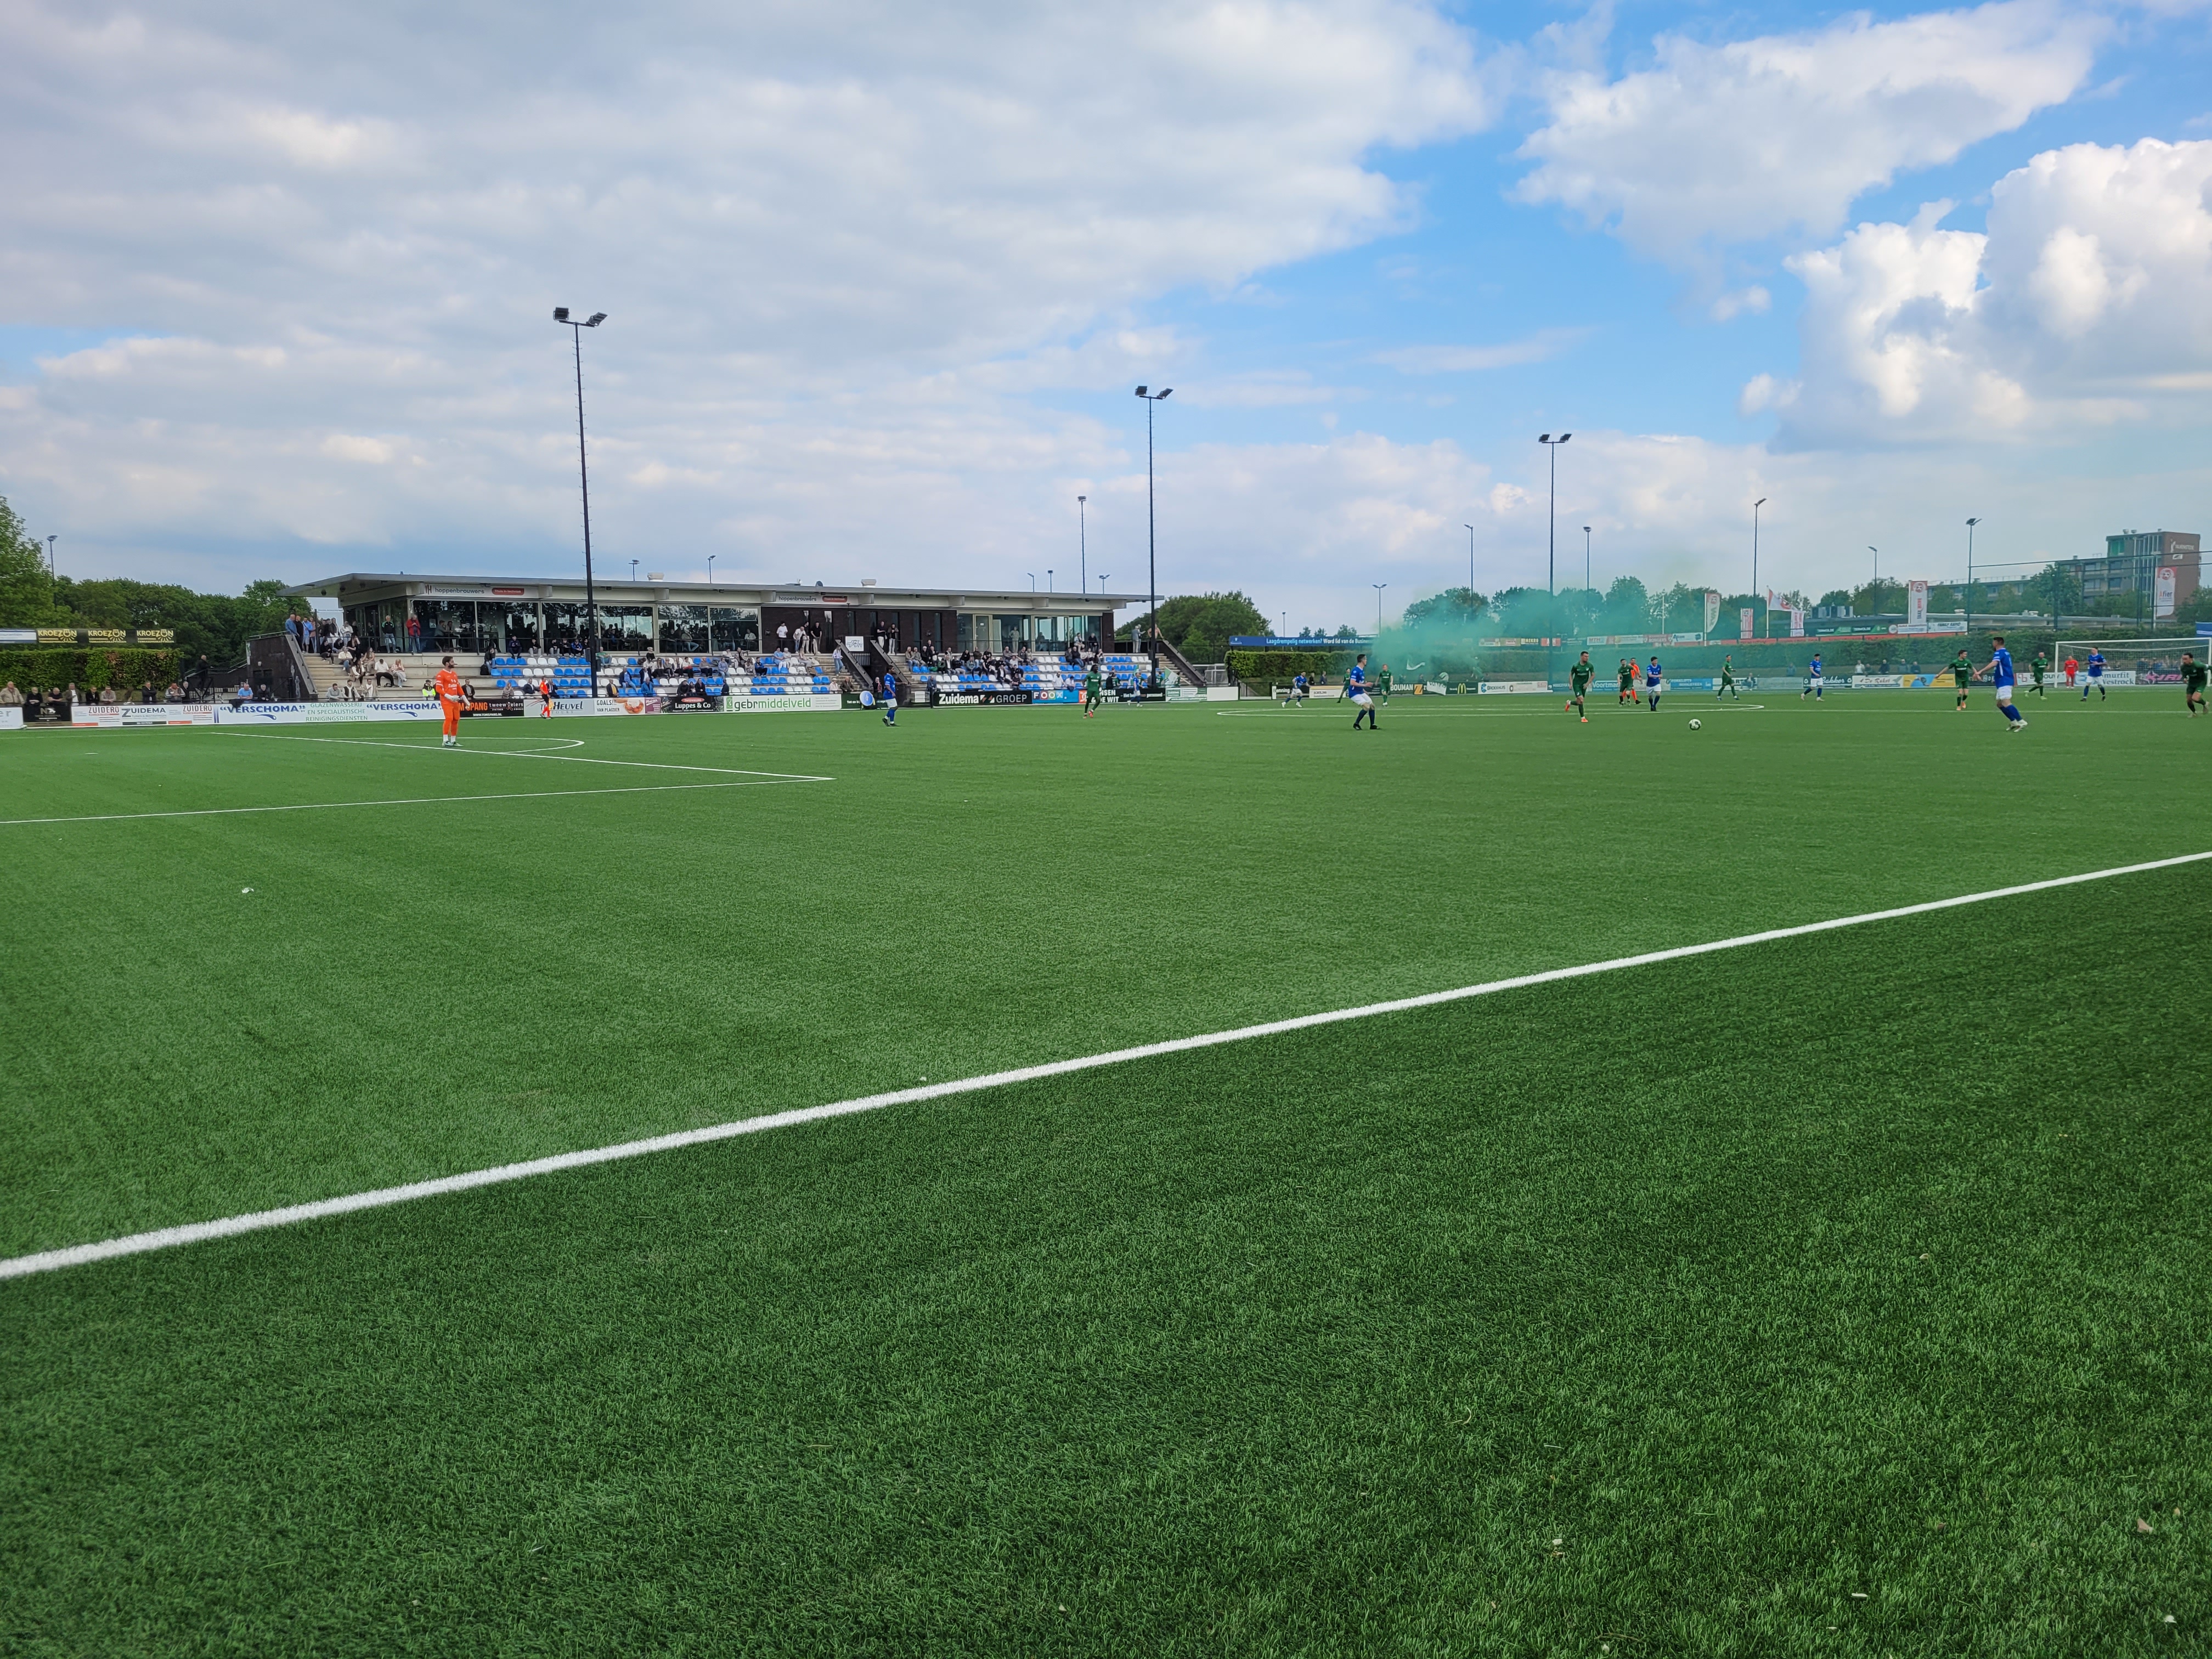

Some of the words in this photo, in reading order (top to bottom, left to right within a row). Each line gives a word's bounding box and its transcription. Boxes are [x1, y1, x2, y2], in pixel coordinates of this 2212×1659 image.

[939, 693, 979, 704] Zuidema
[996, 694, 1027, 703] GROEP
[121, 707, 167, 718] ZUIDEMA
